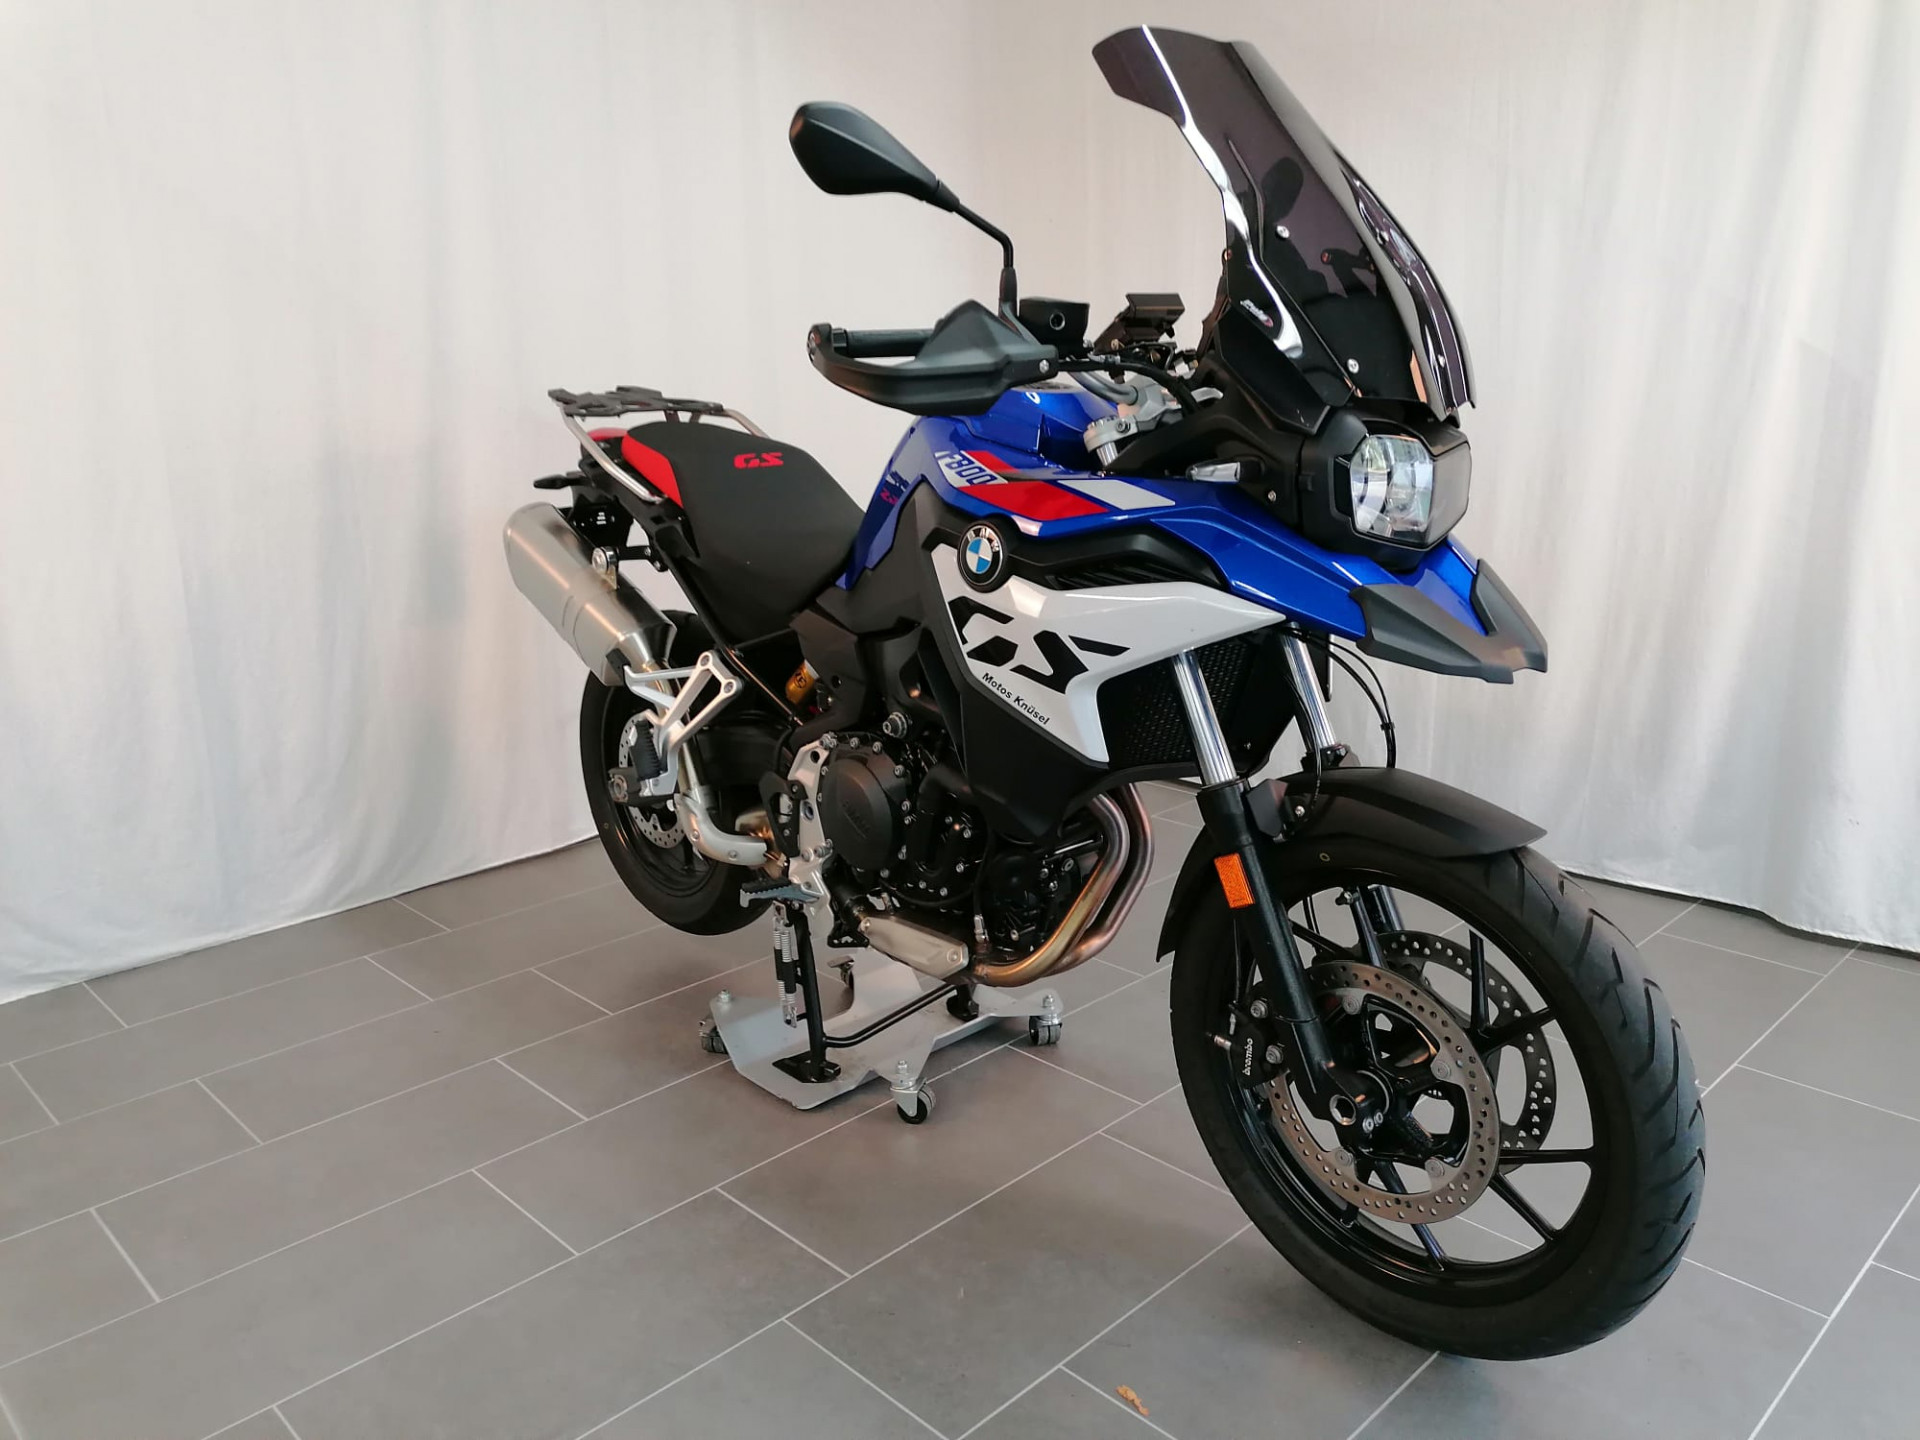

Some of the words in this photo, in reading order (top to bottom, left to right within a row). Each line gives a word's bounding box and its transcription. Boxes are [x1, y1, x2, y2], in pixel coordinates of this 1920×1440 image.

[733, 451, 784, 469] GS
[982, 672, 1013, 699] Motos
[1013, 695, 1050, 725] Knüsel
[1241, 1037, 1253, 1076] brembo
